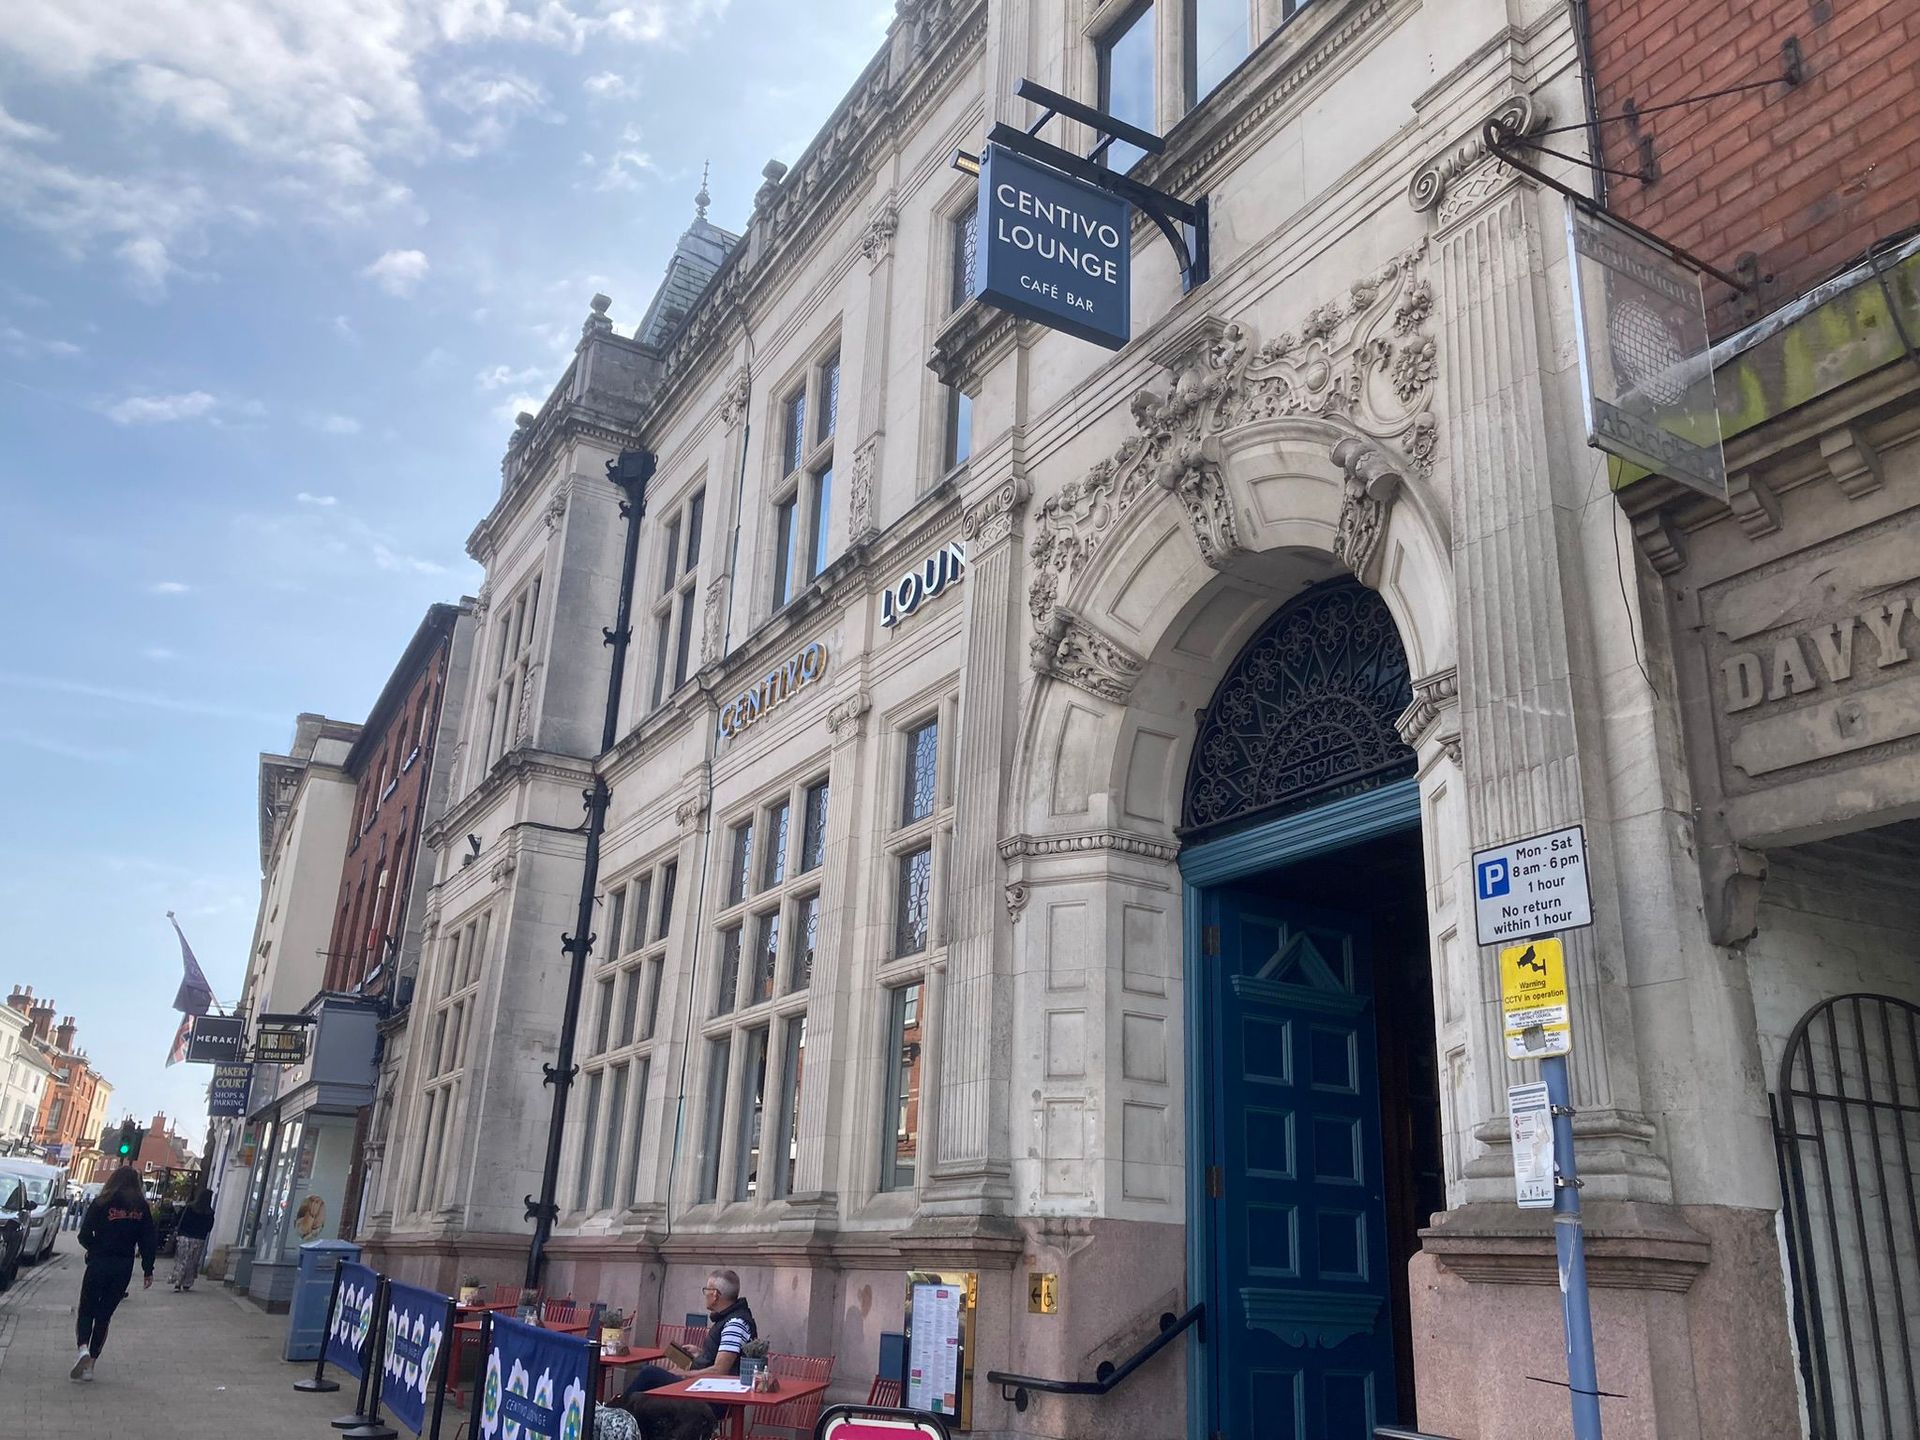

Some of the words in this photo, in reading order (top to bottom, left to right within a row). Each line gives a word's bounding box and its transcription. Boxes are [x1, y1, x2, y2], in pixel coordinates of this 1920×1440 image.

[996, 183, 1119, 248] CENTIVO
[999, 218, 1117, 284] LOUNGE
[1020, 275, 1058, 299] CAFÉ
[1066, 291, 1094, 313] BAR
[1721, 597, 1920, 715] DAVY
[719, 640, 828, 741] CENTIVO
[1516, 846, 1542, 861] Mon
[1550, 835, 1574, 852] Sat
[1512, 865, 1521, 878] 8
[1522, 863, 1541, 876] am
[1549, 856, 1558, 869] 6
[1560, 853, 1580, 869] pm
[1484, 863, 1505, 896] P
[1527, 881, 1534, 893] 1
[1537, 876, 1566, 891] hour
[1501, 905, 1520, 919] No
[1522, 897, 1562, 914] return
[1493, 918, 1532, 935] within
[1534, 914, 1540, 928] 1
[1543, 910, 1573, 926] hour
[1519, 979, 1547, 990] Warning
[1504, 996, 1523, 1005] CCTV
[1532, 989, 1565, 1002] operation
[196, 1034, 237, 1044] MERAKI
[215, 1066, 250, 1077] BAKERY
[214, 1091, 238, 1099] SHOPS
[215, 1078, 248, 1089] COURT
[213, 1099, 244, 1107] PARKING
